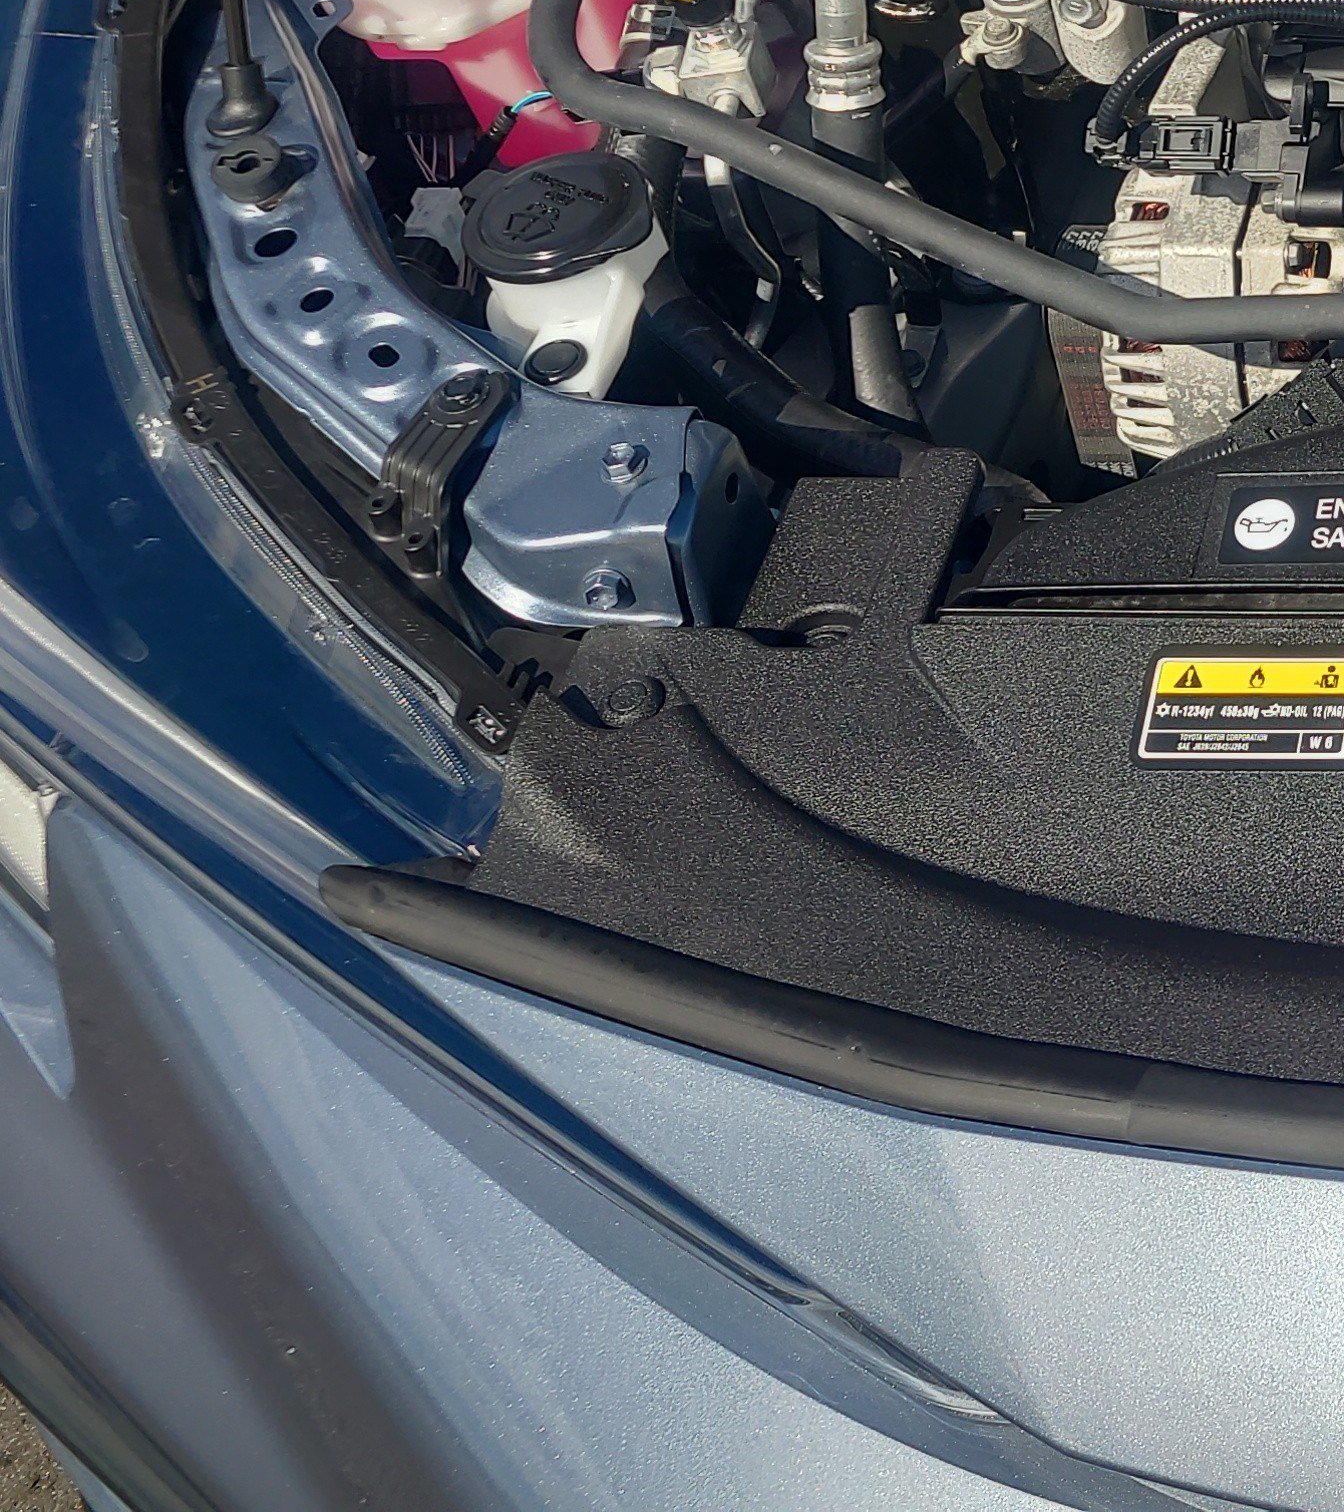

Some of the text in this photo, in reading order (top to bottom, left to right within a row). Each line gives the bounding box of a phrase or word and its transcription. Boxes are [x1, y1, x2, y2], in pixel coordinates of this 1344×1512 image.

[1312, 705, 1323, 718] 12
[1180, 733, 1268, 742] TOYOTA MOTOR CORPORATION
[1309, 737, 1323, 749] W
